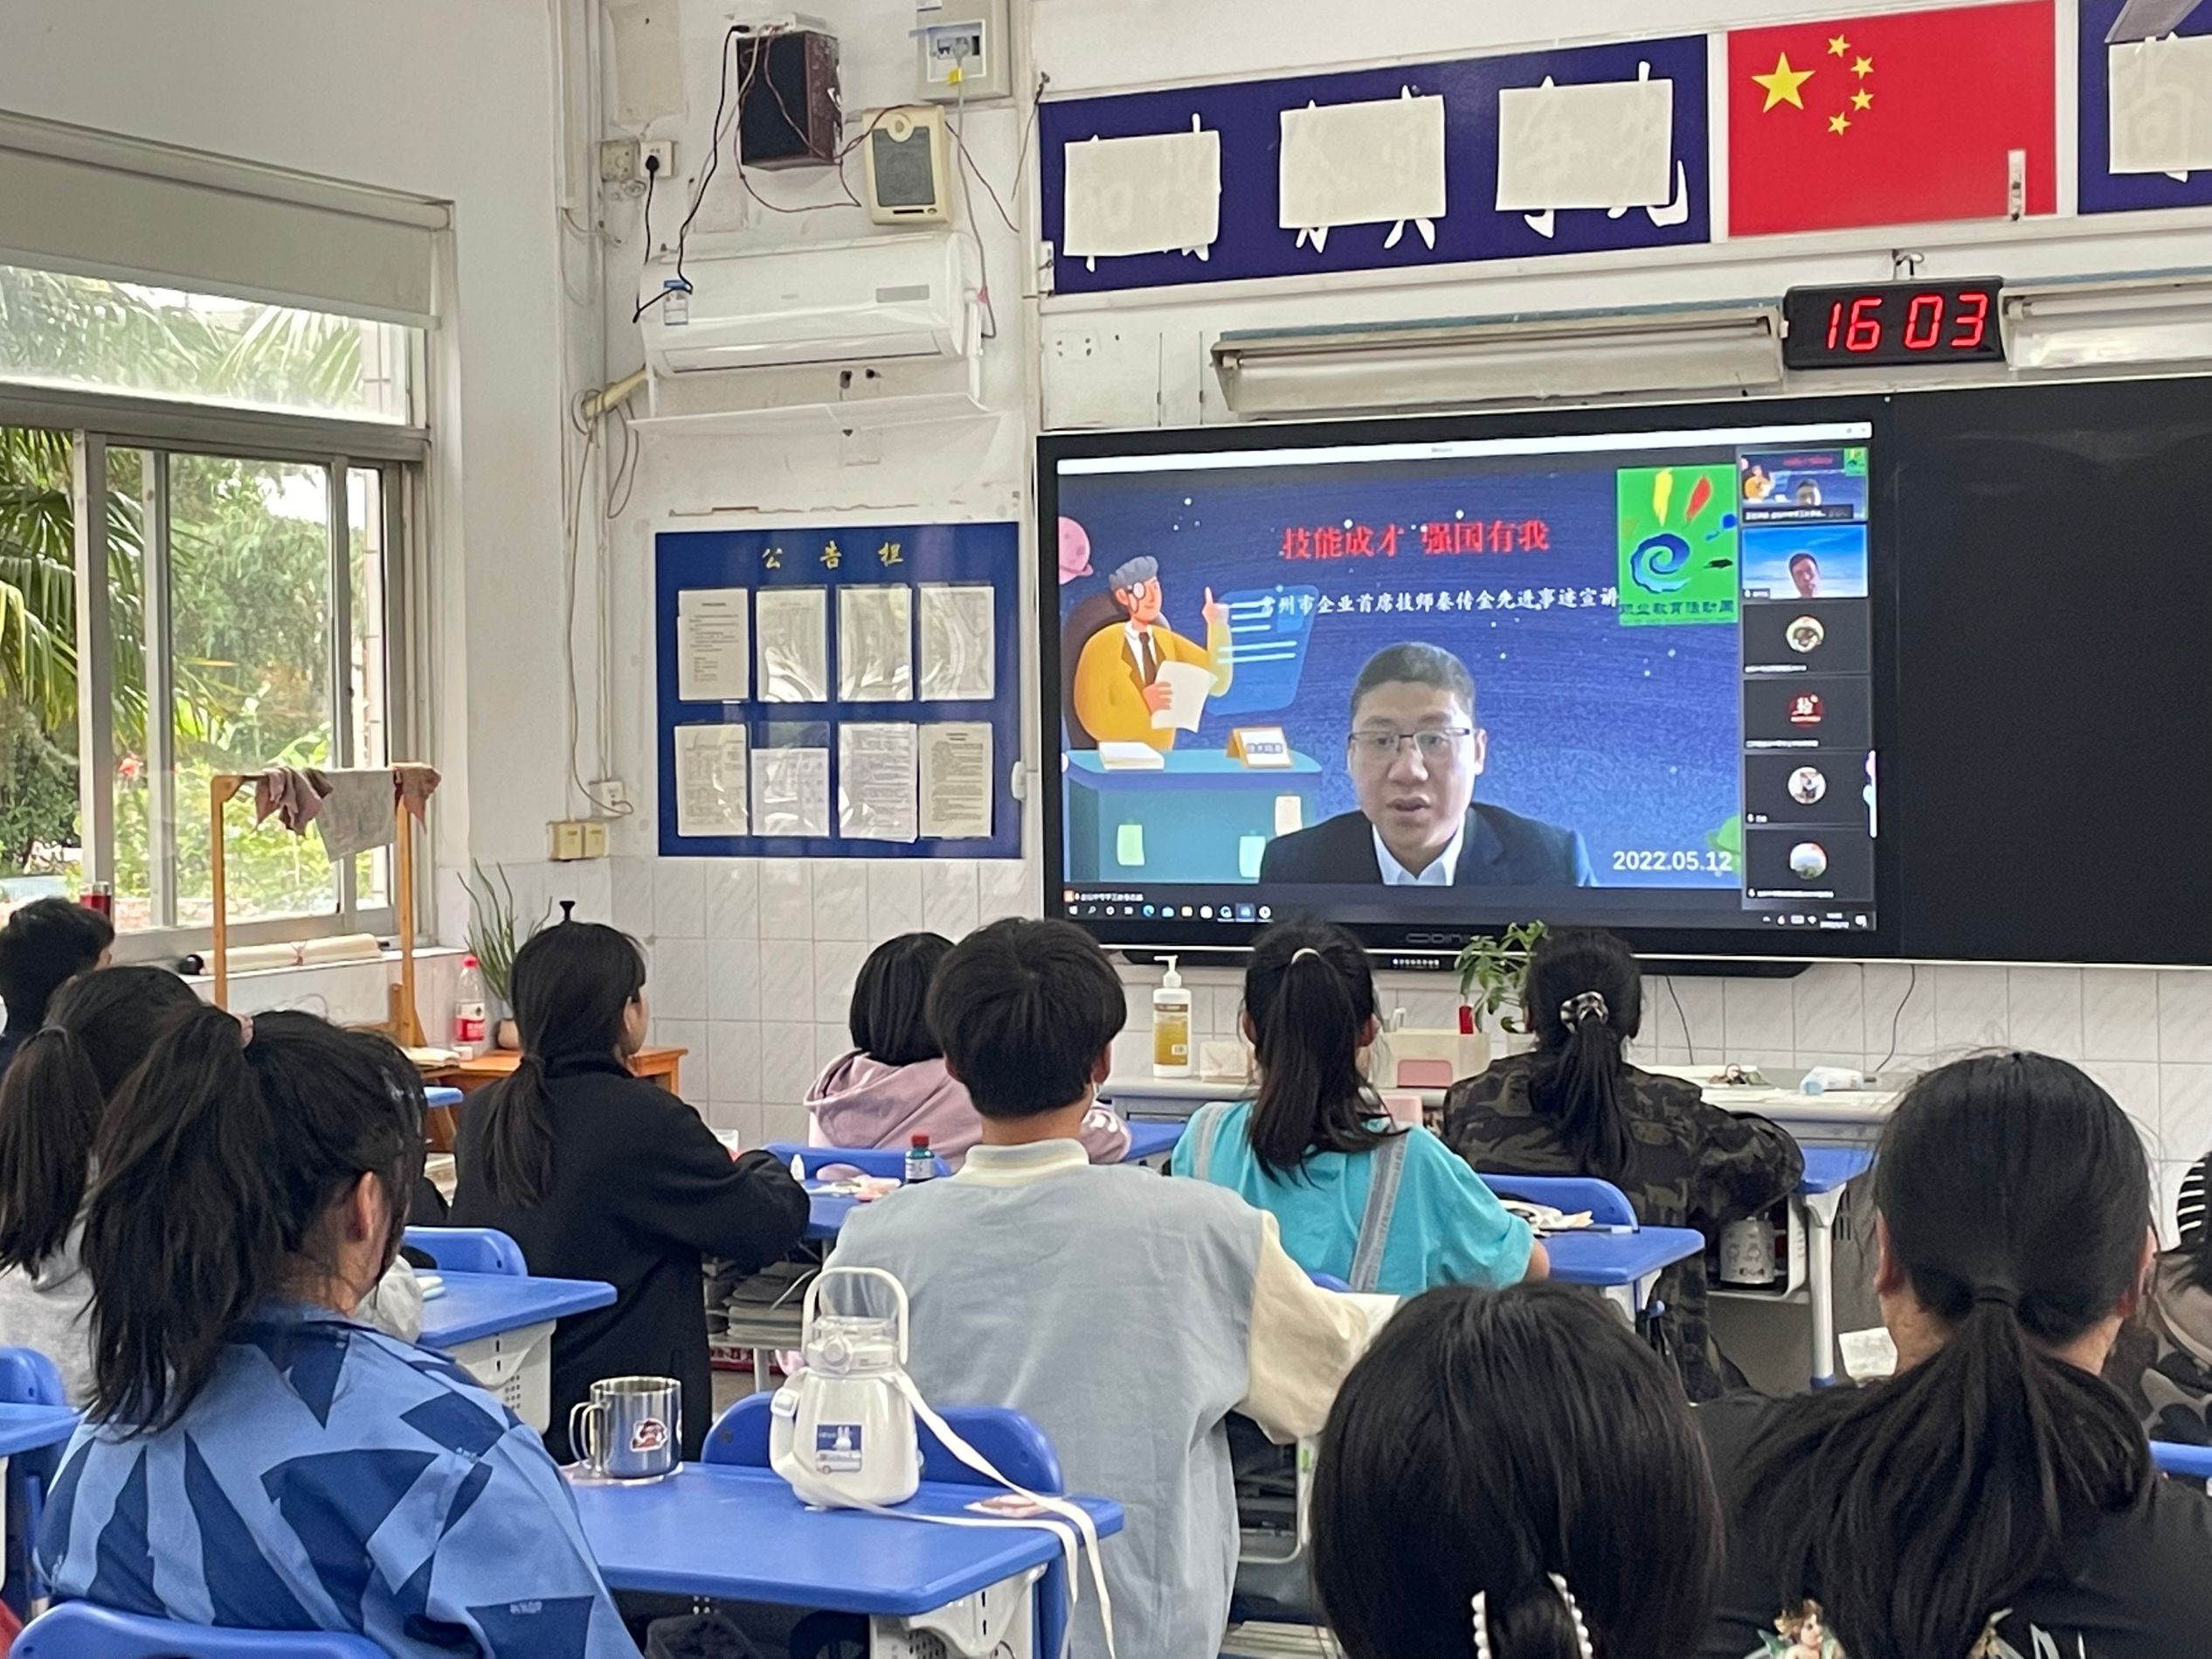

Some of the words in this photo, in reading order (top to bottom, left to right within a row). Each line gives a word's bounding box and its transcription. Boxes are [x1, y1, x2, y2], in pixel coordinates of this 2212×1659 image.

[1826, 298, 1883, 353] 16
[1903, 293, 1990, 349] 03
[1282, 523, 1400, 559] 技能成才
[1421, 519, 1551, 555] 强国有我
[1612, 850, 1733, 871] 2022.05.12
